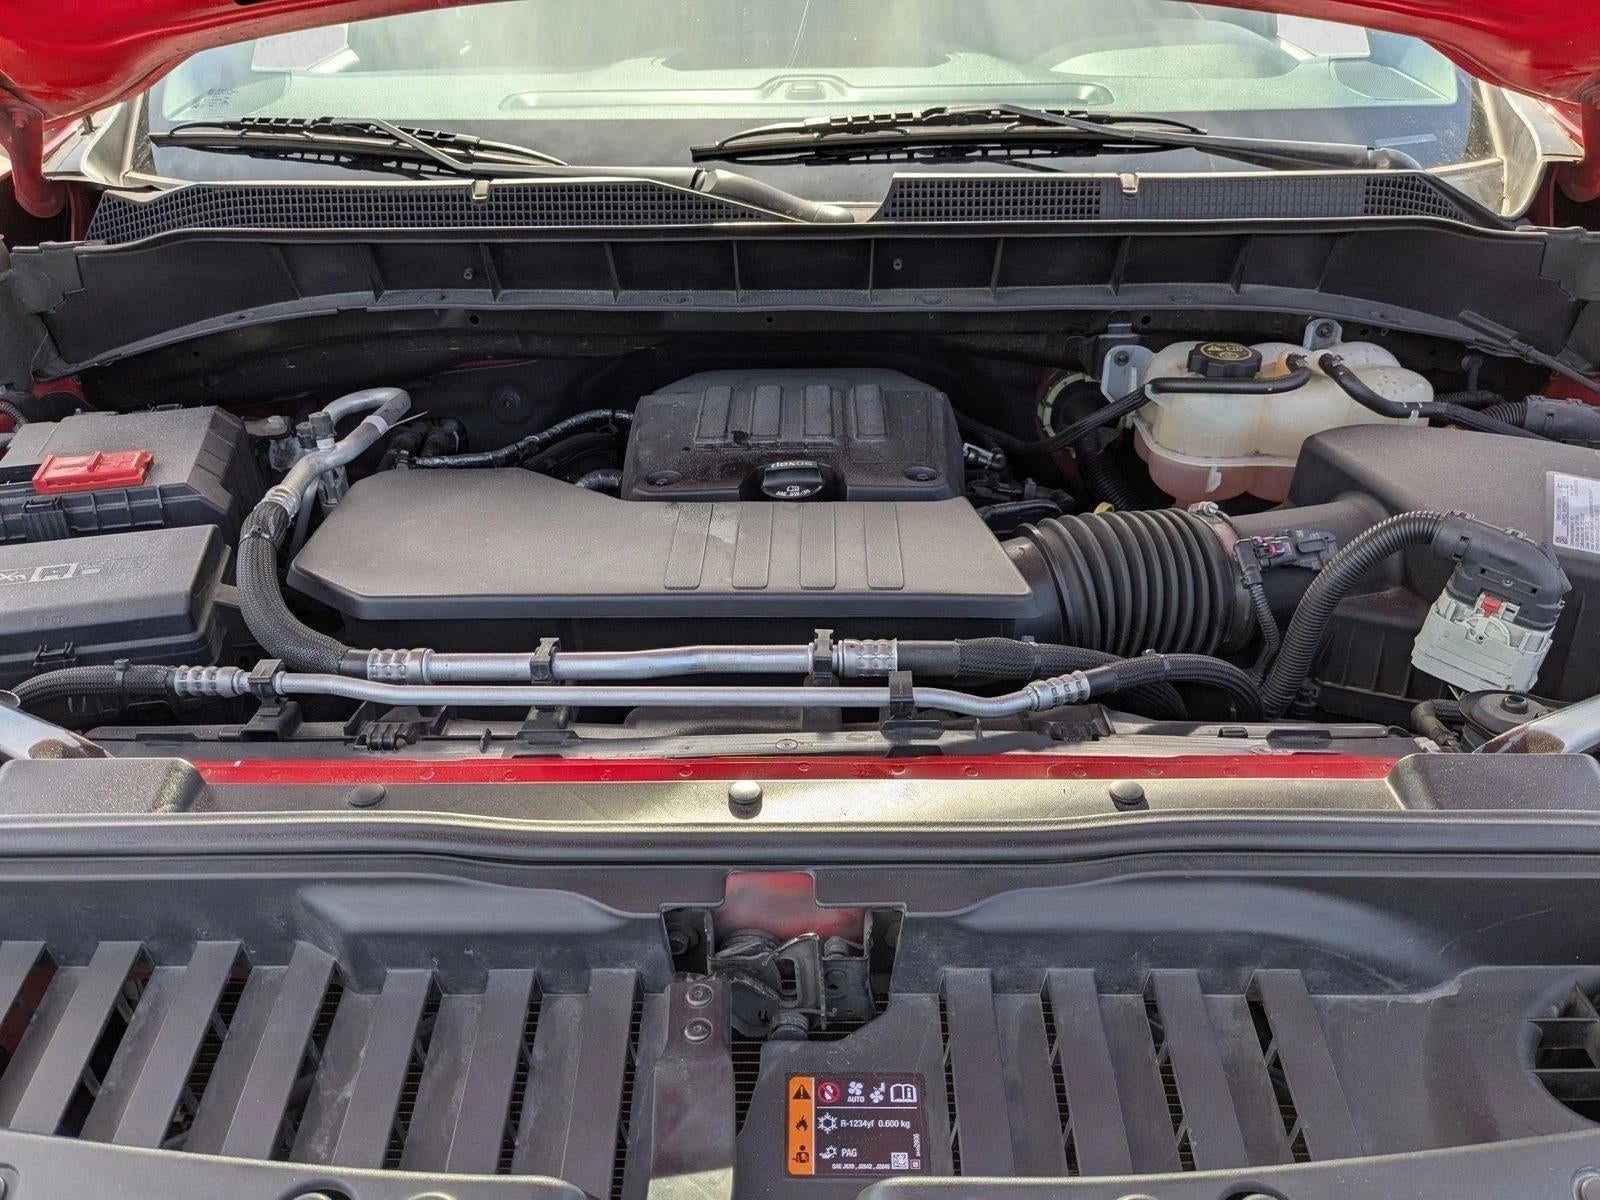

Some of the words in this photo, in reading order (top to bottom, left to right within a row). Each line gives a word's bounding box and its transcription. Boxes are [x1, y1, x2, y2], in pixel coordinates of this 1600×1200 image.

[840, 1119, 875, 1129] R-1234yf
[878, 1120, 899, 1128] 0.600
[900, 1120, 911, 1129] kg
[841, 1148, 858, 1157] PAG
